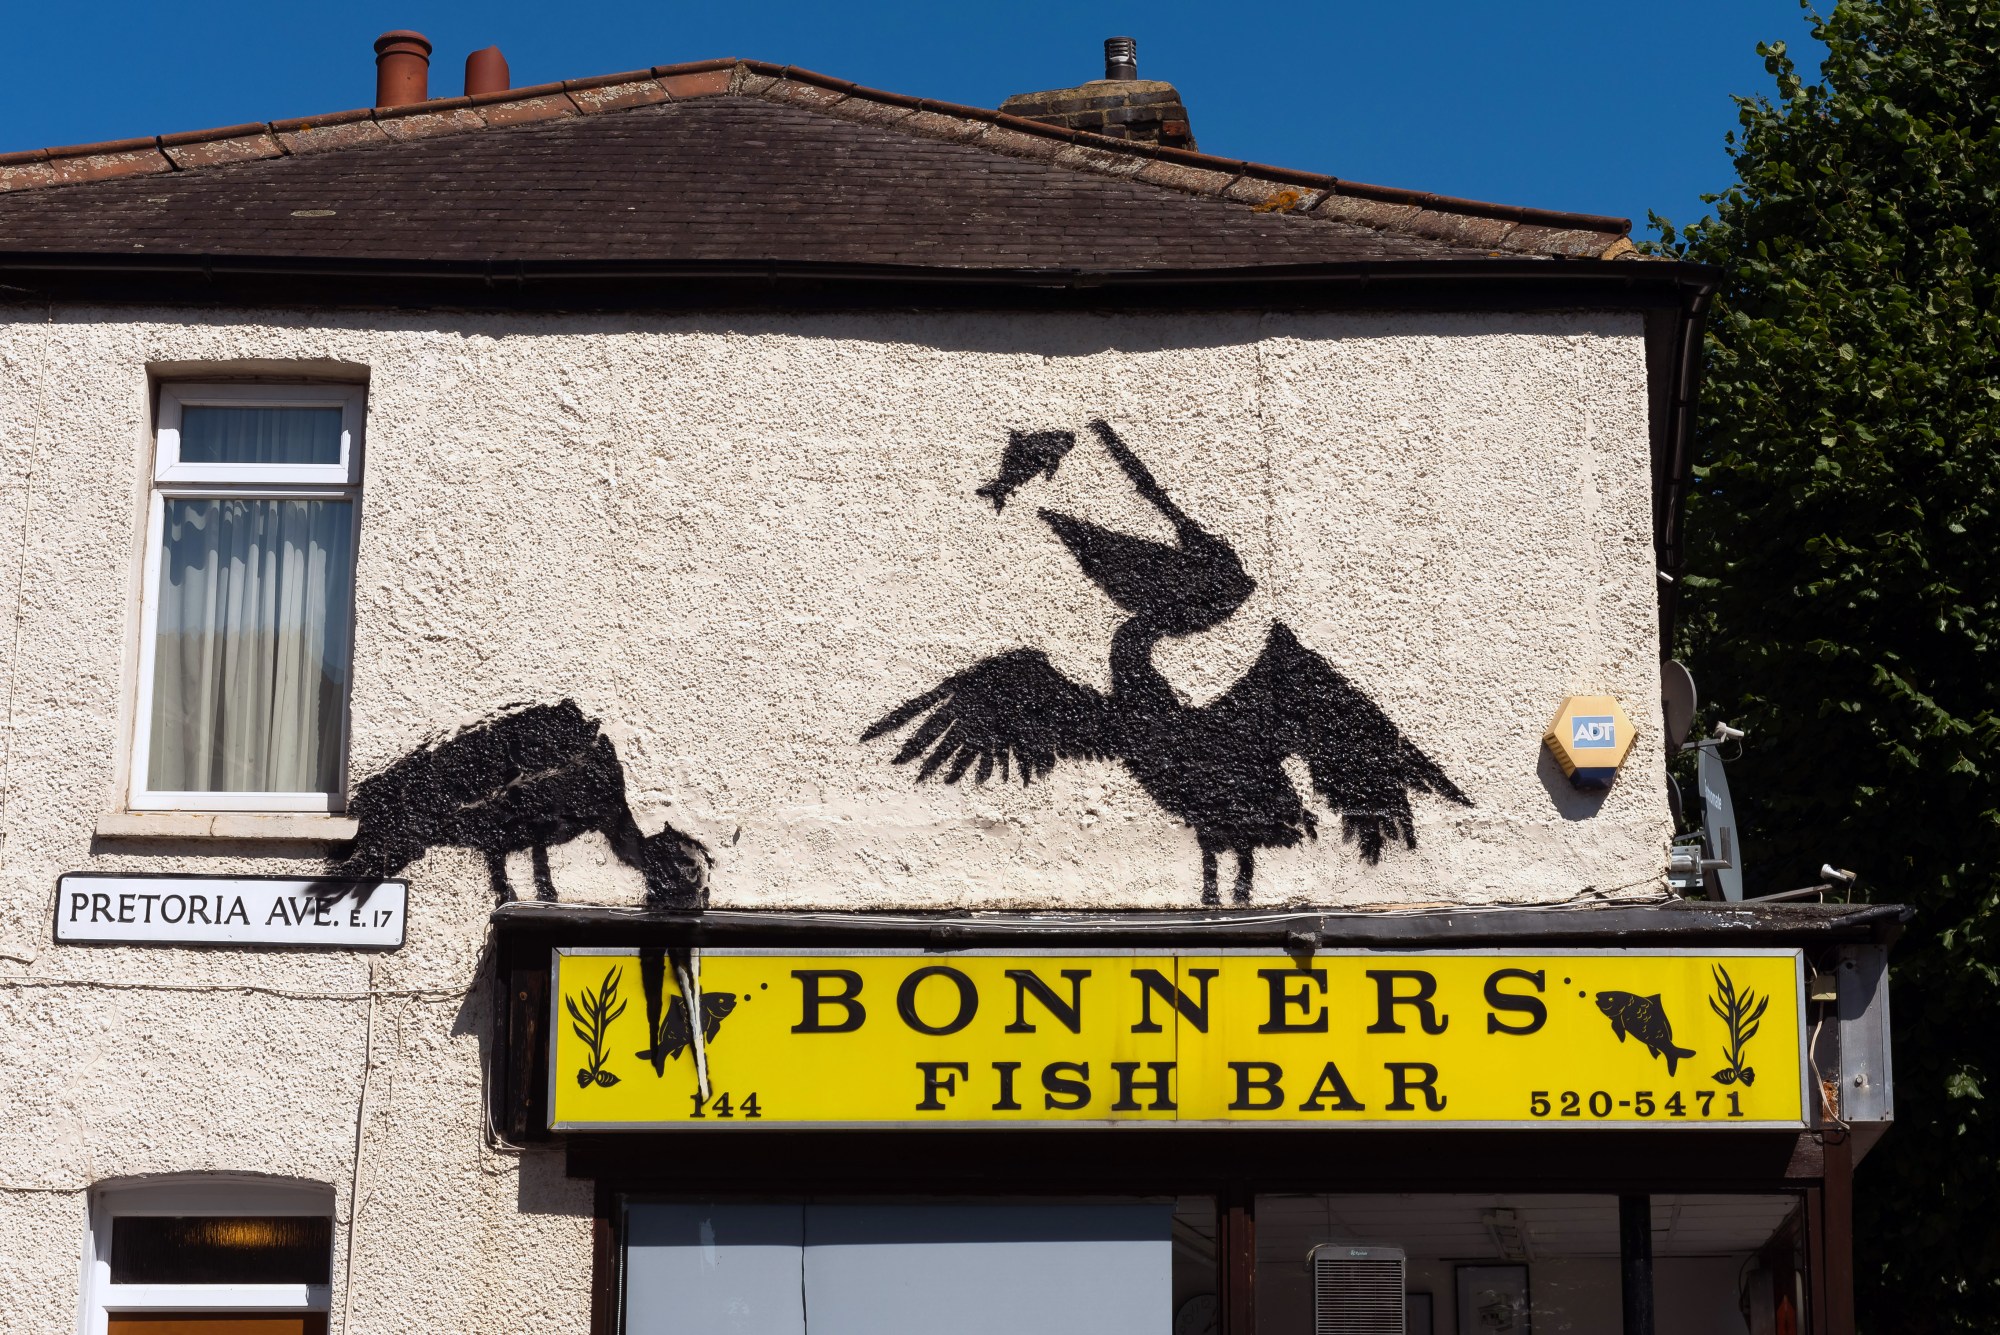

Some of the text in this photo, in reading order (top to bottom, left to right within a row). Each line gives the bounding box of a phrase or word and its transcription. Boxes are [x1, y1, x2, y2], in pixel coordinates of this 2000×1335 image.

[1574, 722, 1614, 742] ADT
[69, 892, 251, 926] PRETORIA
[265, 896, 339, 927] AVE.
[790, 964, 1548, 1036] BONNERS
[915, 1061, 1447, 1113] FISH BAR
[689, 1091, 762, 1118] 144
[1530, 1090, 1745, 1118] 520-5471
